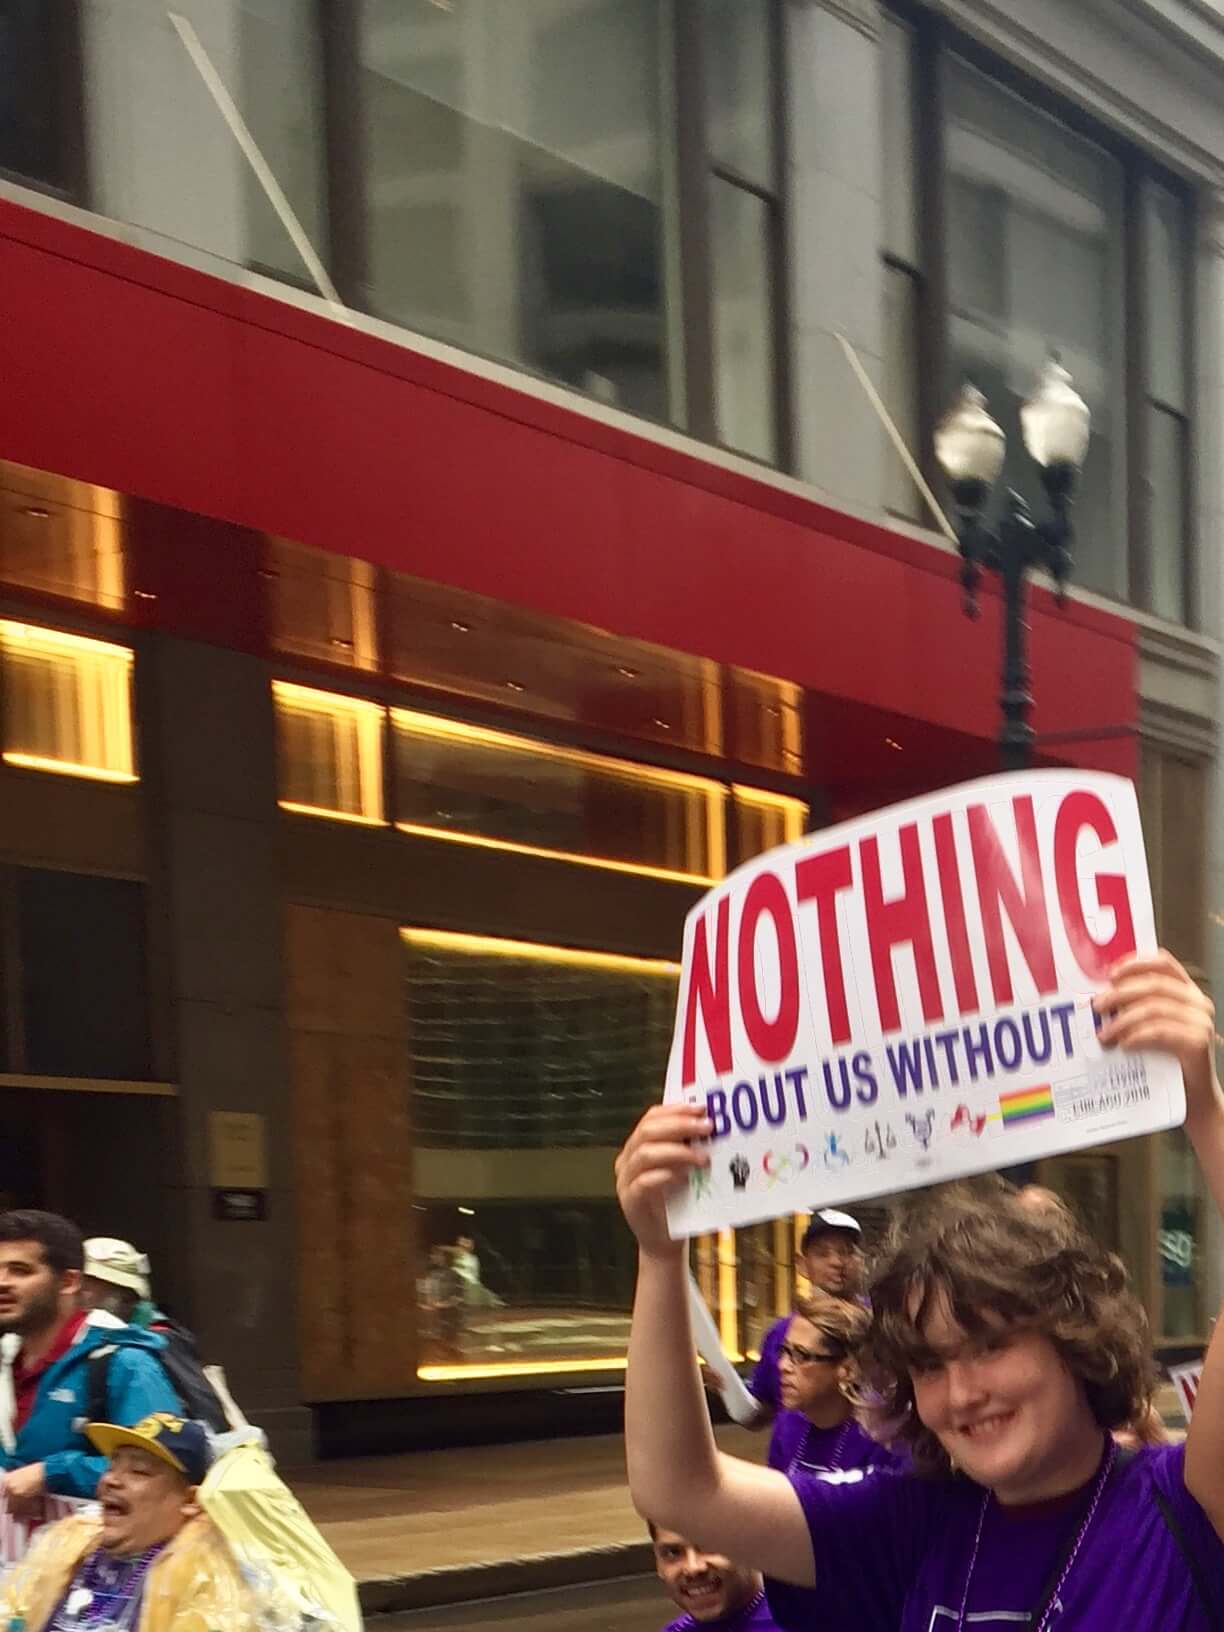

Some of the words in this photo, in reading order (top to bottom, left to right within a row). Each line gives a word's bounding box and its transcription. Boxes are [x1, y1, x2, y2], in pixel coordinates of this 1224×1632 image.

[681, 789, 1137, 1087] NOTHING
[706, 1066, 812, 1140] BOUT
[822, 1051, 880, 1114] US
[886, 1001, 1077, 1097] WITHOUT
